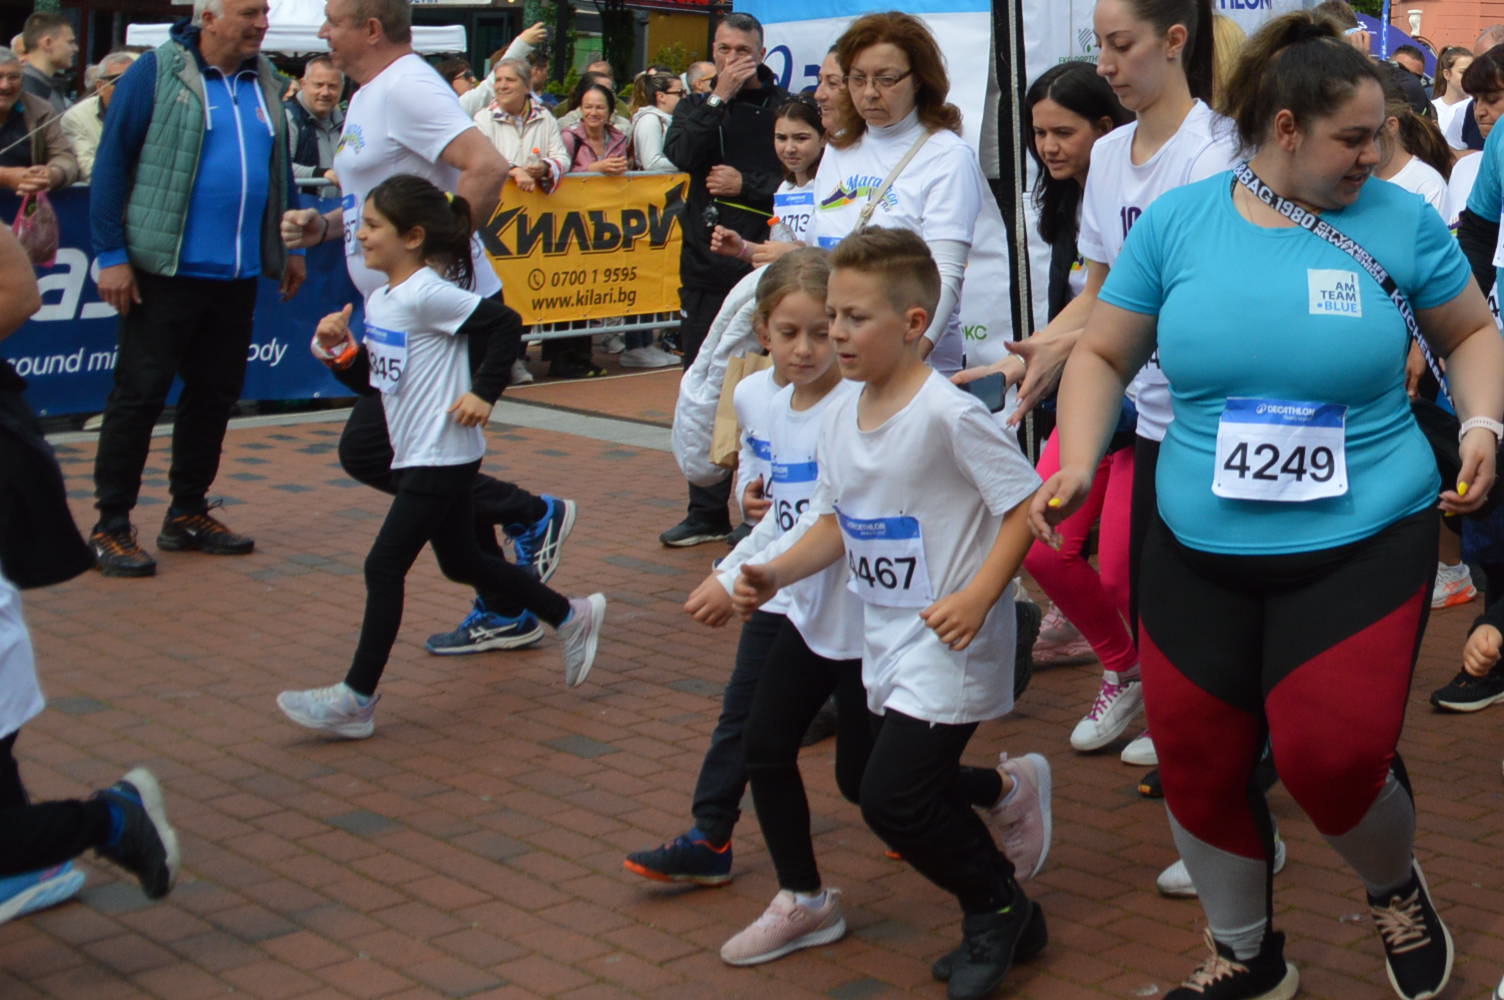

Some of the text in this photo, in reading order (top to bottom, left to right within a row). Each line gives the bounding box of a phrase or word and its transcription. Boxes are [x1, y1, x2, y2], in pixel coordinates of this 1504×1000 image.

[551, 266, 638, 288] 0700 1 9595
[1320, 290, 1357, 302] TEAM
[1335, 282, 1356, 293] AM
[532, 287, 637, 311] www.kilari.bg
[1324, 301, 1358, 313] BLUE
[247, 337, 288, 367] ody
[1267, 404, 1316, 417] DECATHLON
[1223, 441, 1336, 483] 4249
